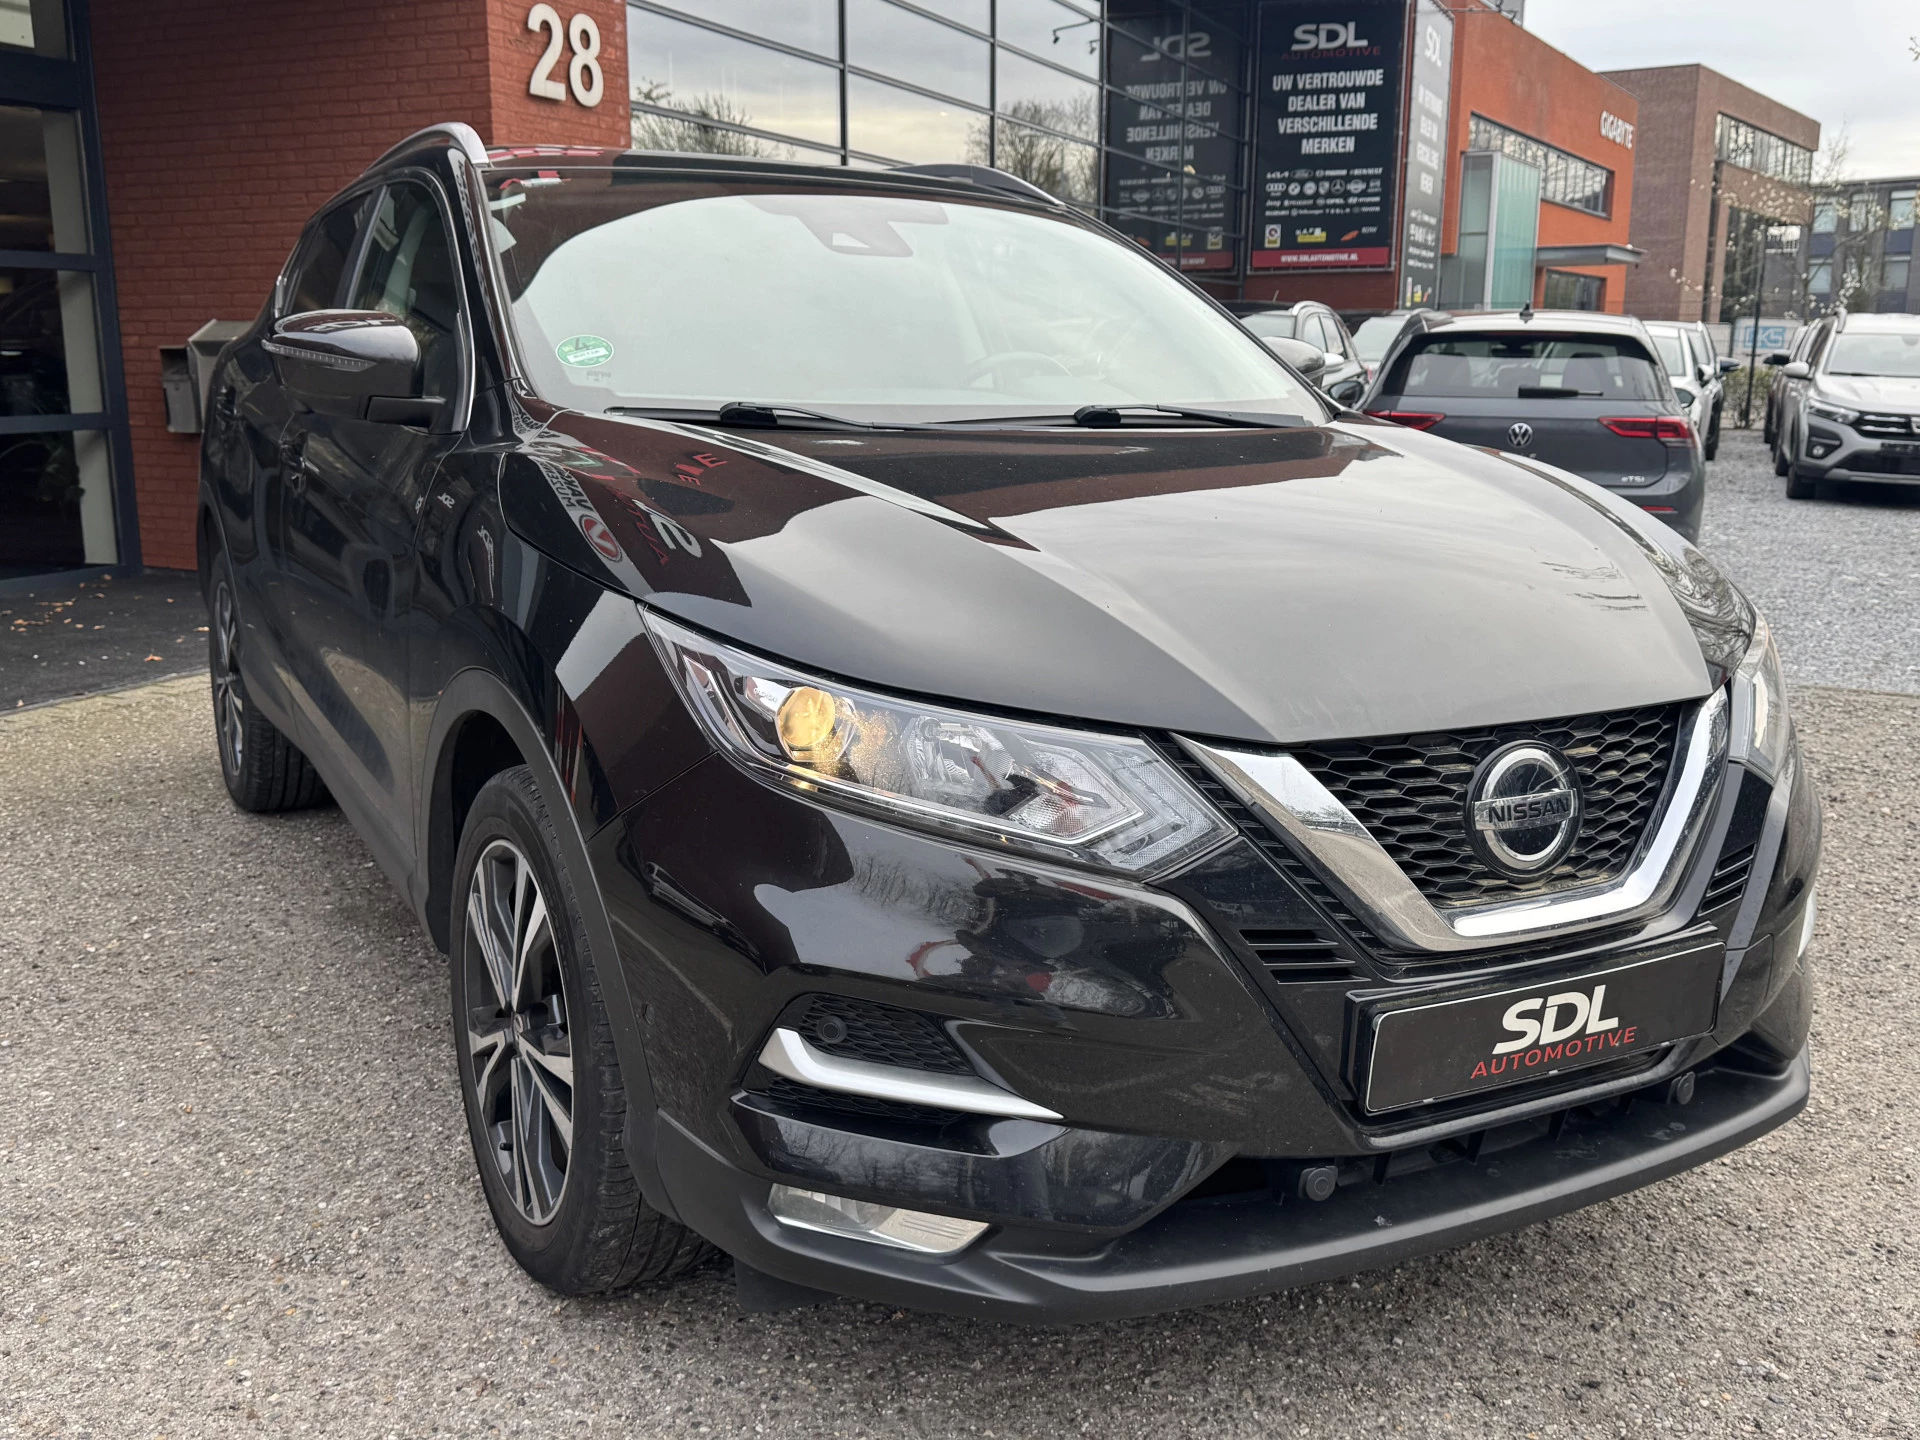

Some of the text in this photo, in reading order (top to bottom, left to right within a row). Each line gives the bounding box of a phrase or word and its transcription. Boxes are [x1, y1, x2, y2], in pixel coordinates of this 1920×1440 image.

[1291, 21, 1368, 51] SDL
[527, 3, 604, 108] 28
[1281, 46, 1380, 60] AUTOMOTIVE
[1272, 69, 1384, 91] UW VERTROUWDE
[1288, 92, 1366, 112] DEALER VAN
[1278, 113, 1378, 134] VERSCHILLENDE
[1301, 136, 1355, 155] MERKEN
[1489, 796, 1570, 824] NISSAN
[1492, 984, 1619, 1055] SDL
[1470, 1026, 1638, 1080] AUTOMOTIVE
